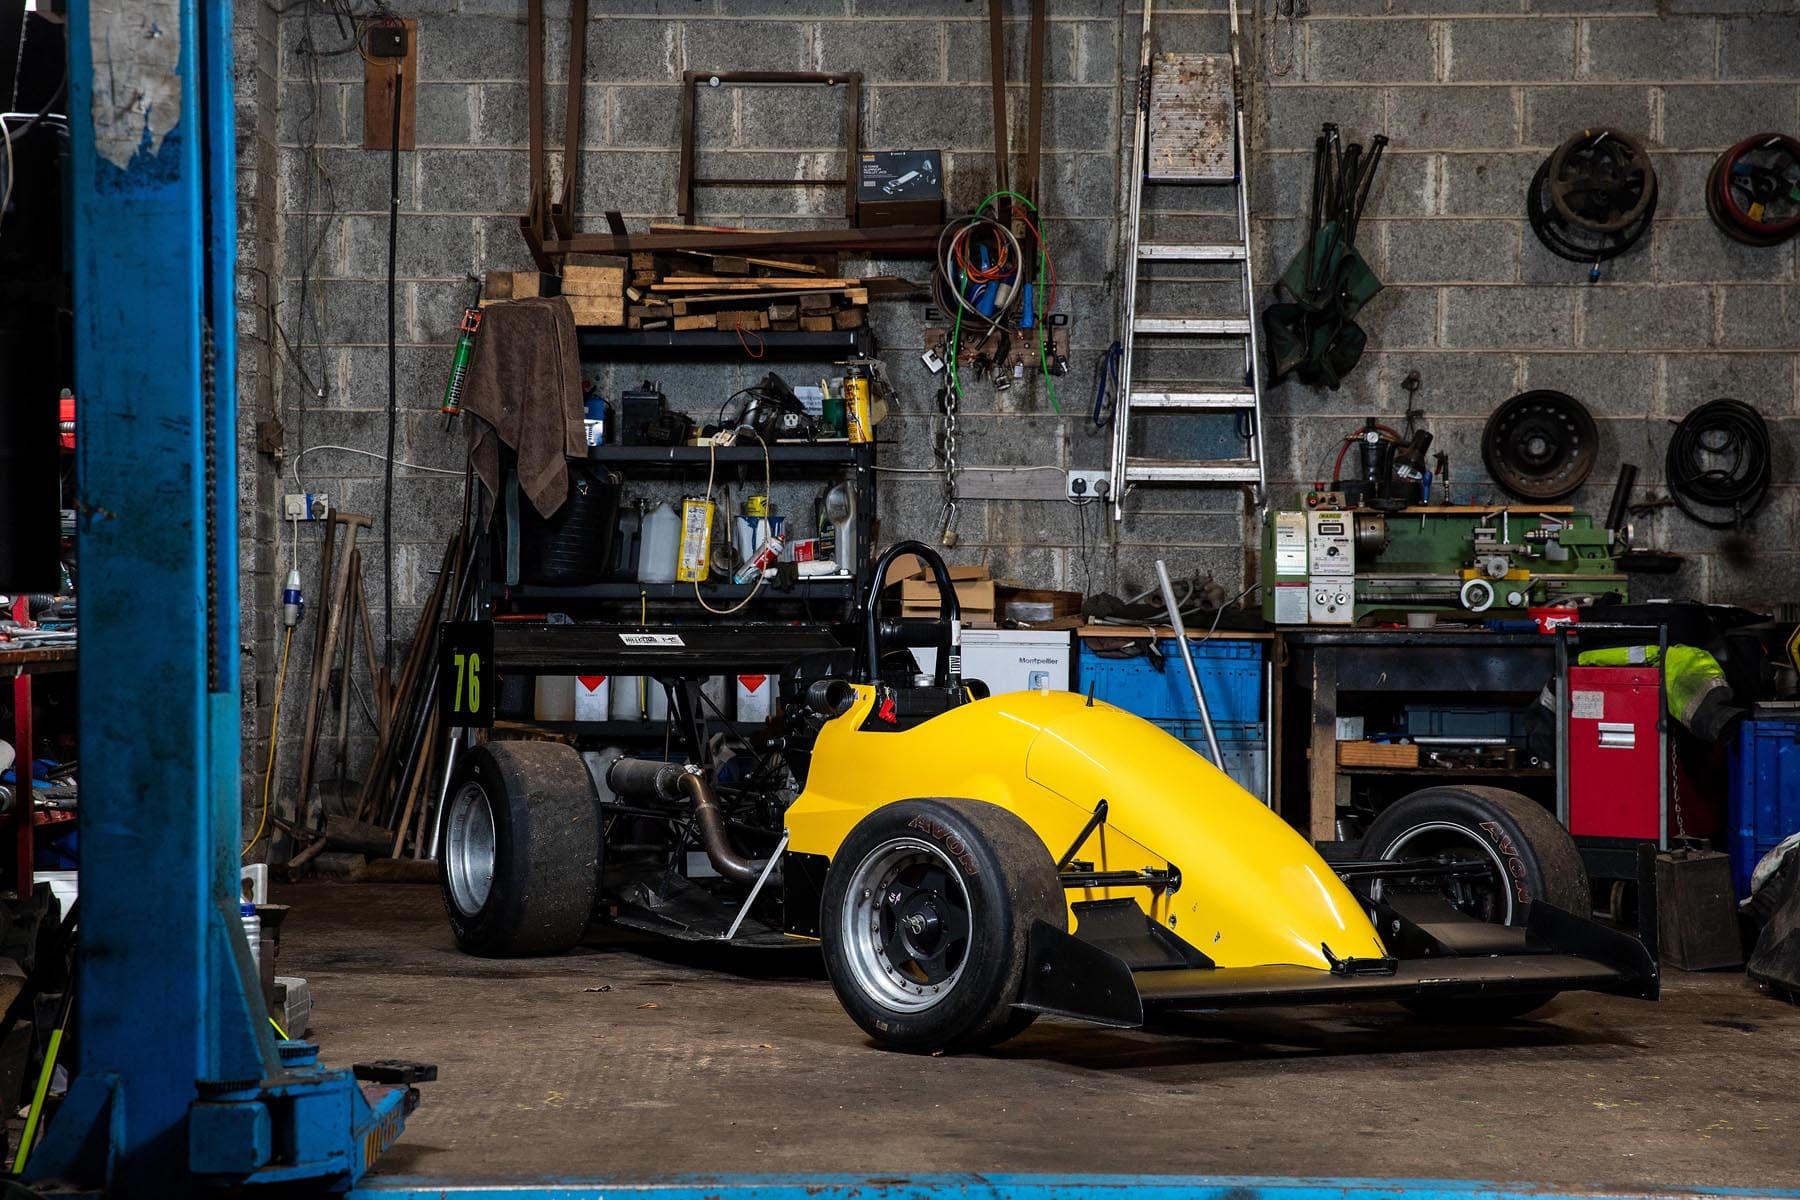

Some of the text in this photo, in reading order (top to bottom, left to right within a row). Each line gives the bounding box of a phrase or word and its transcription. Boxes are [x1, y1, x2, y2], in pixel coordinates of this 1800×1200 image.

[454, 652, 480, 713] 76
[1019, 656, 1058, 665] Montpellier
[908, 815, 980, 876] AVON
[1479, 821, 1532, 904] AVON
